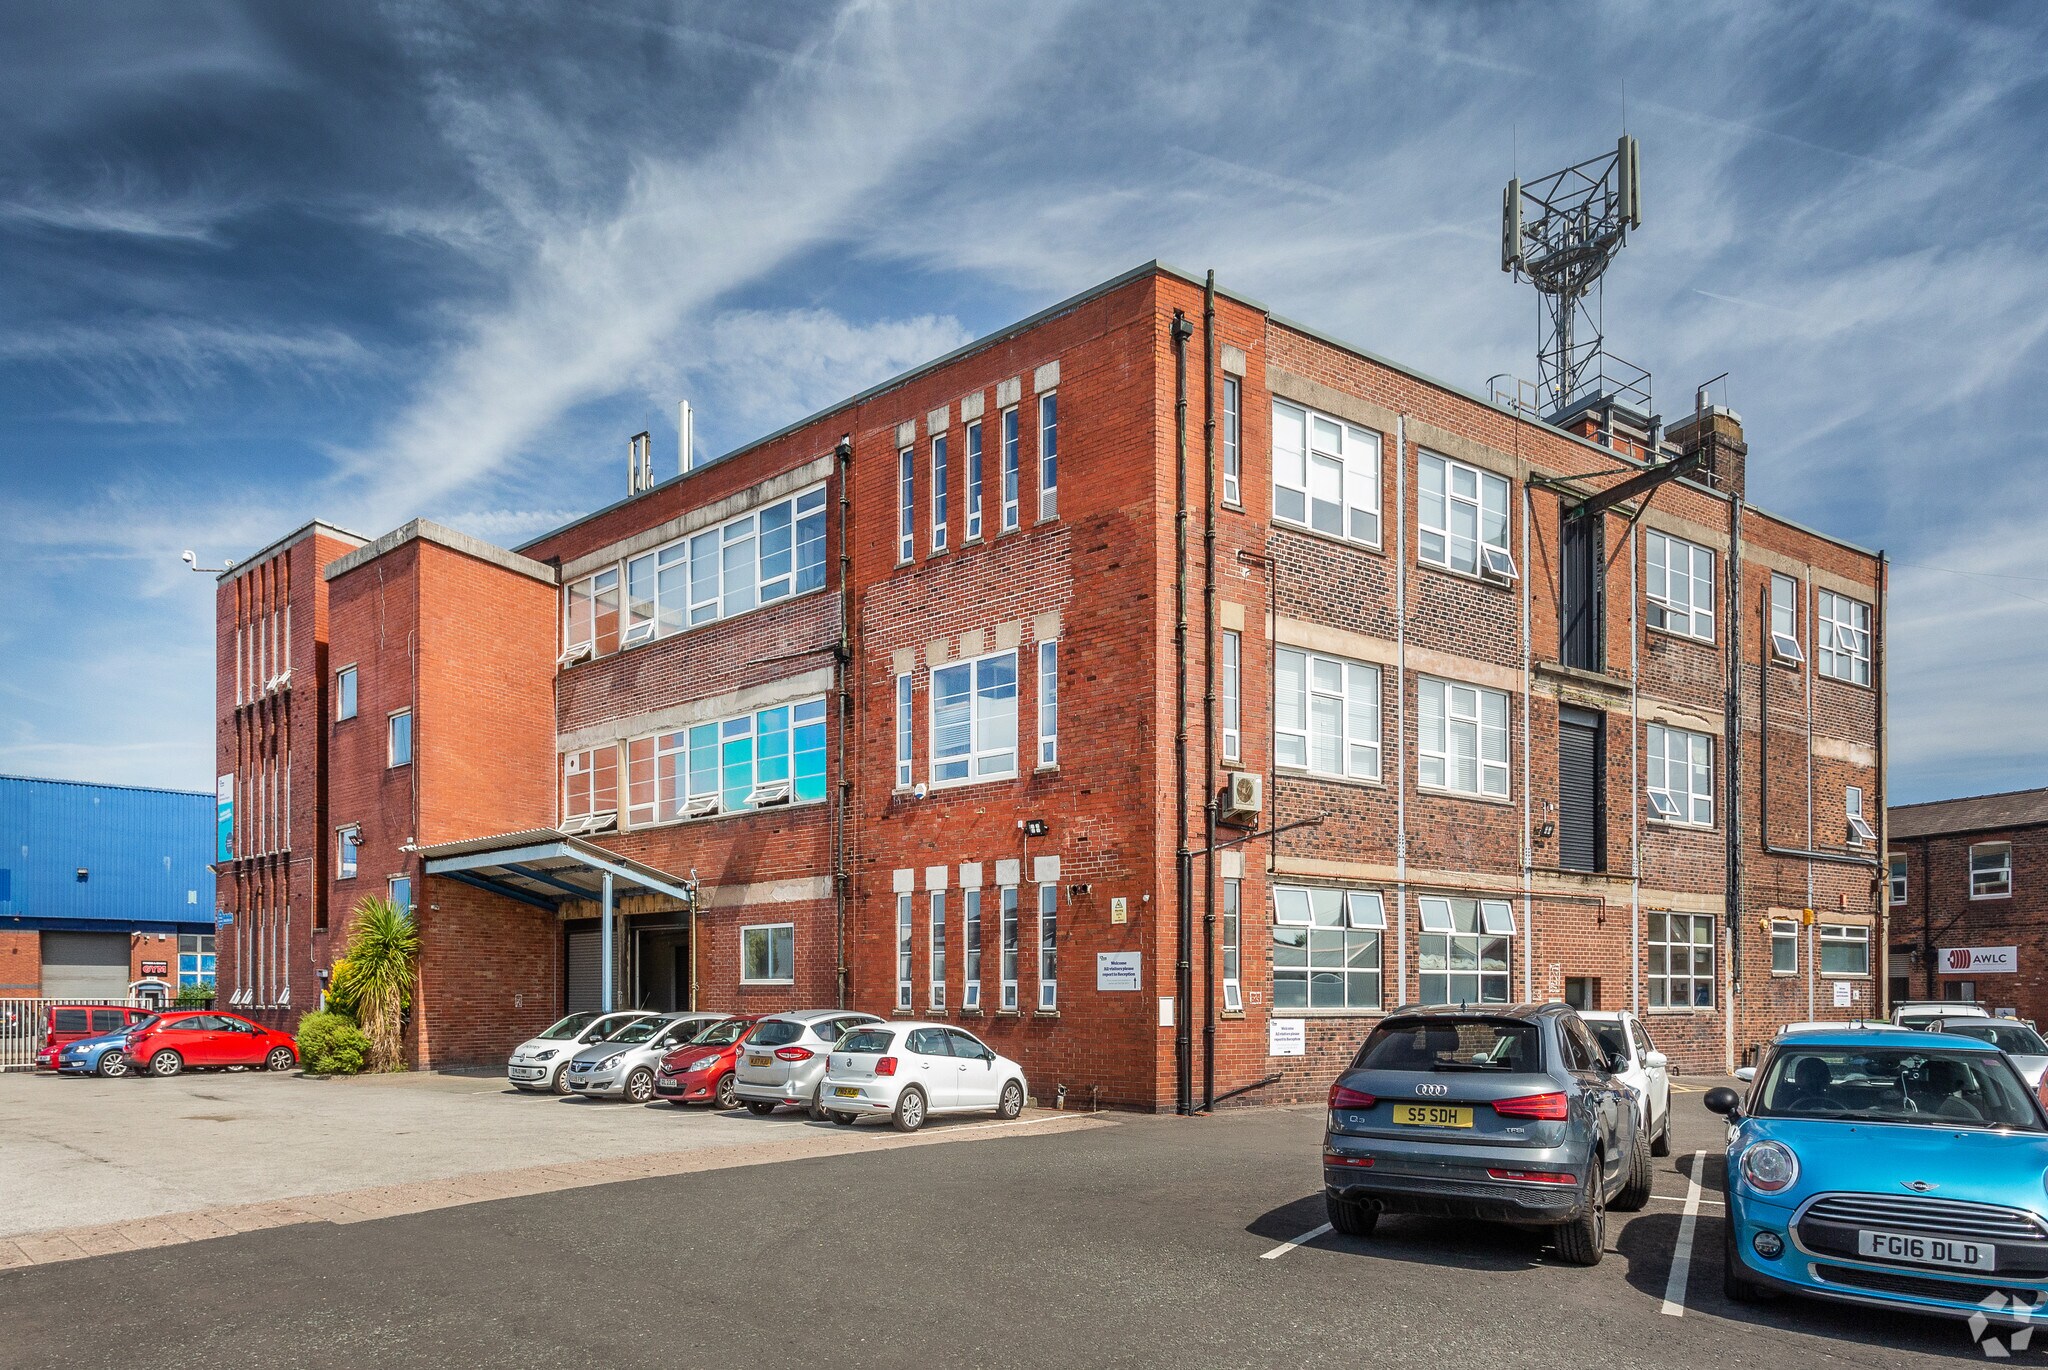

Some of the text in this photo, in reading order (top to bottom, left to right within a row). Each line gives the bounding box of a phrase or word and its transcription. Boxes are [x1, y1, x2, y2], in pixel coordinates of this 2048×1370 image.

[1973, 954, 2007, 964] AWLC
[142, 965, 167, 974] GYM
[1349, 1115, 1366, 1124] Q3
[1408, 1107, 1458, 1124] S5 SDH
[1872, 1234, 1978, 1265] FG16 DLD
